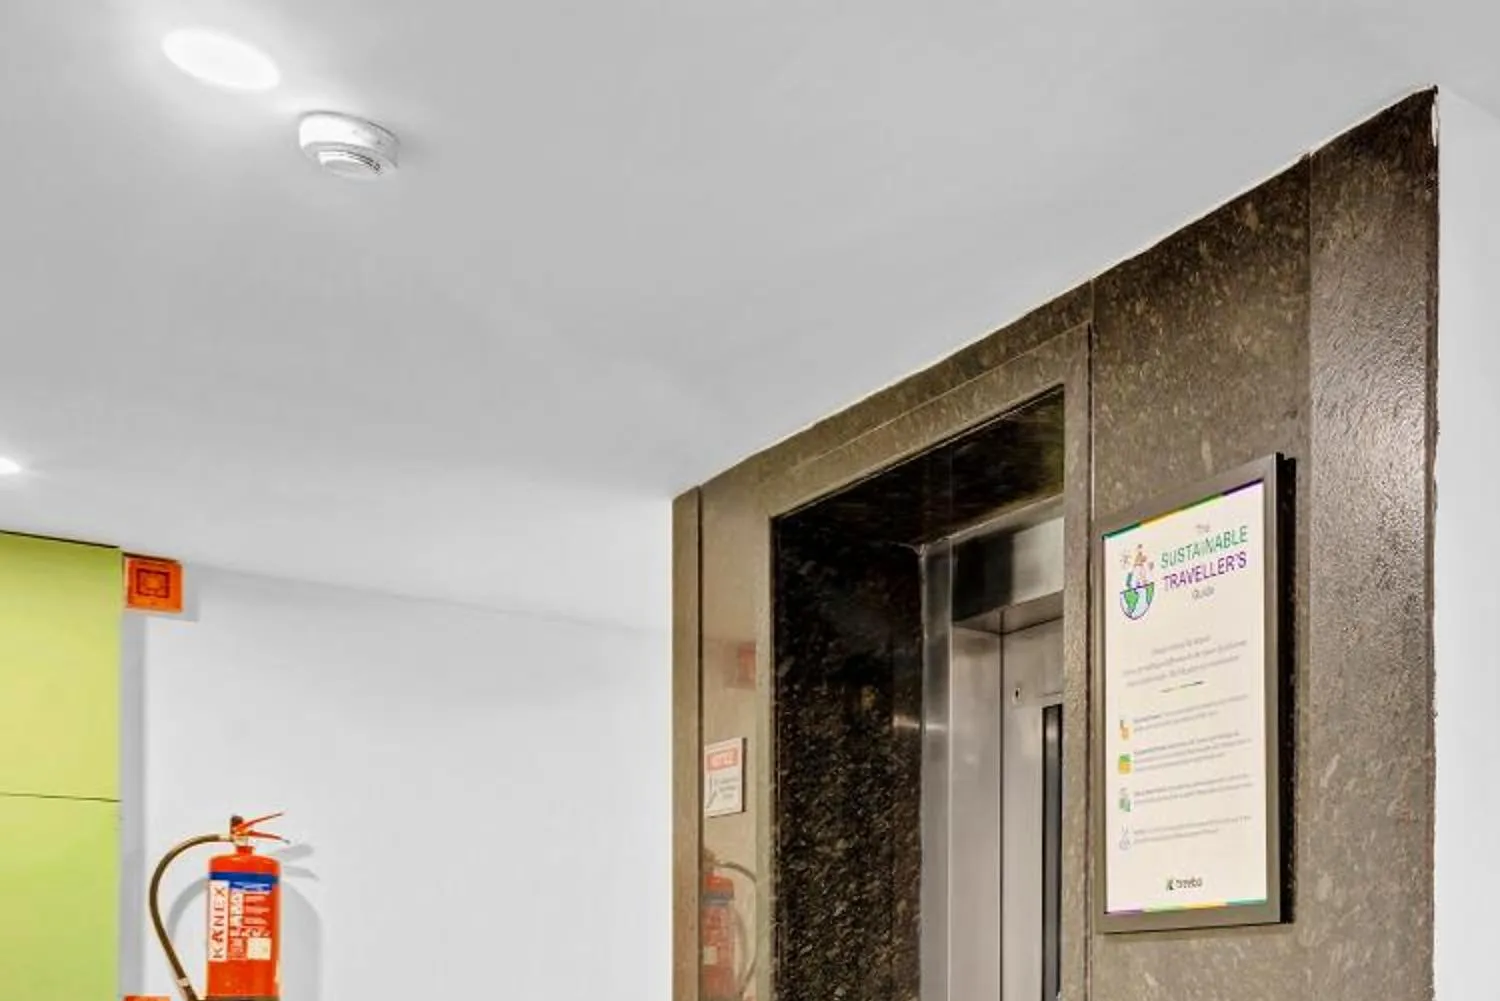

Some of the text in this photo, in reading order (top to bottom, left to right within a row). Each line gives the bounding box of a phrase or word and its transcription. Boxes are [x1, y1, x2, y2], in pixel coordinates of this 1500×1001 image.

[1161, 525, 1248, 569] SUSTAINABLE
[1163, 551, 1247, 592] TRAVELLER'S
[212, 886, 225, 958] KANEX
